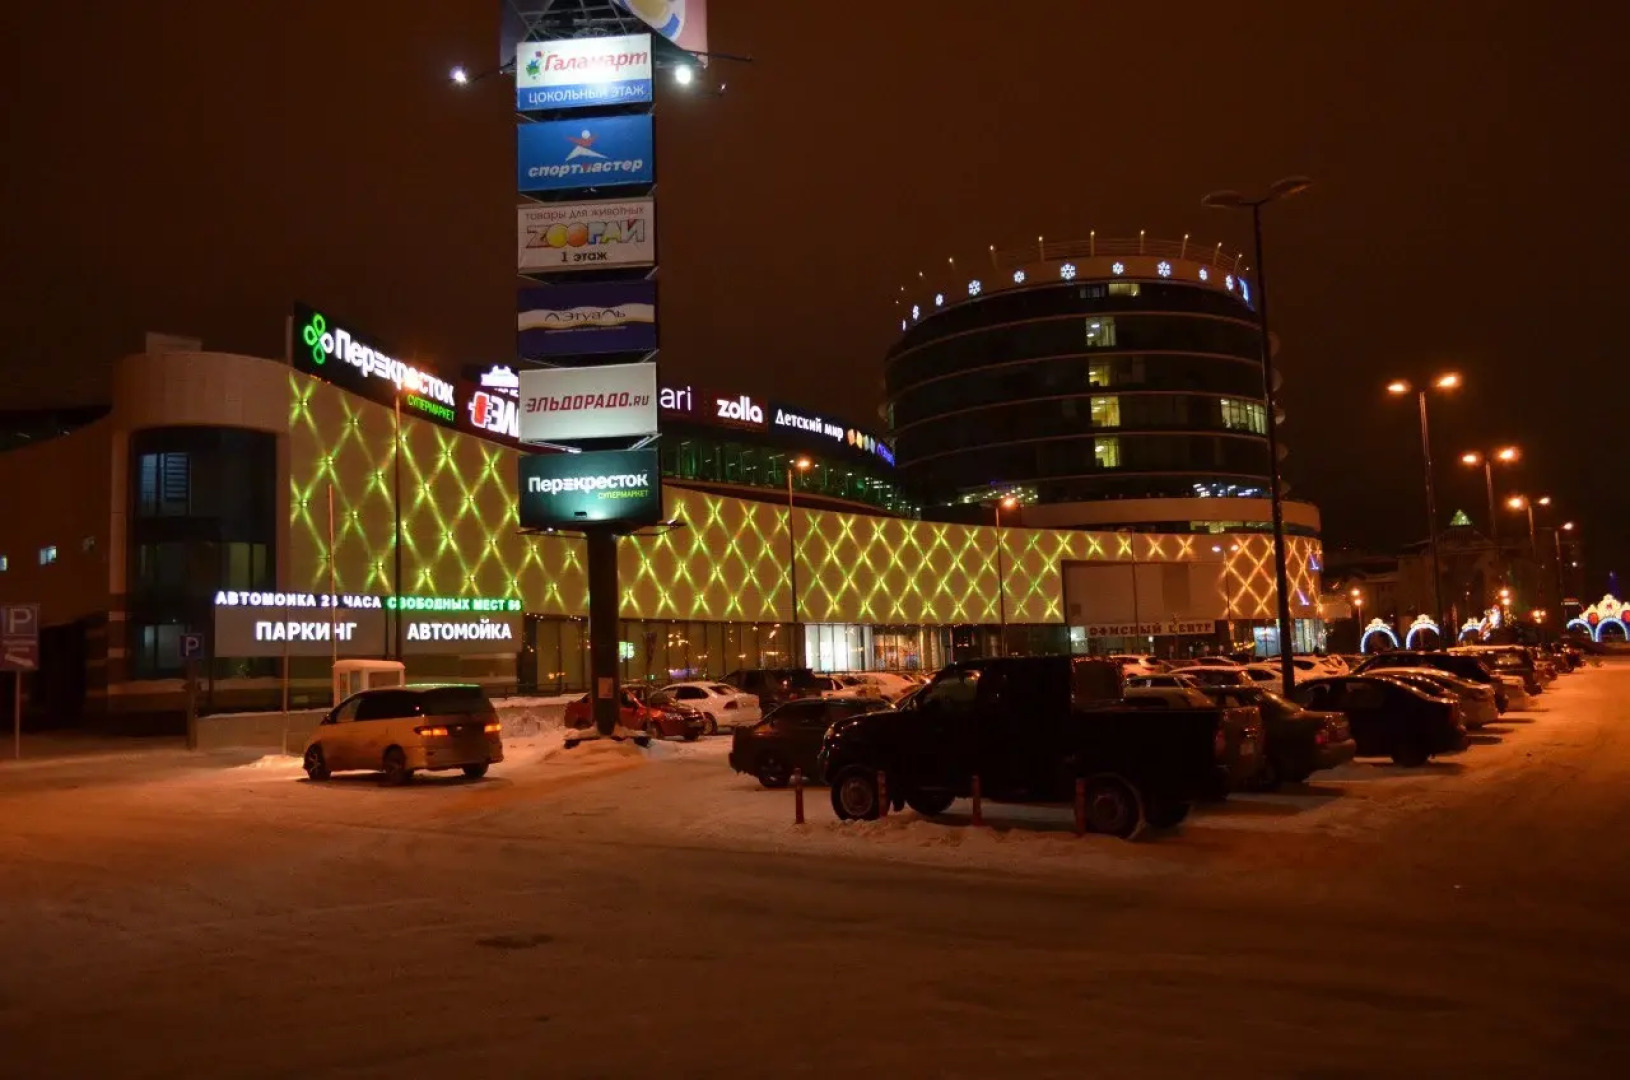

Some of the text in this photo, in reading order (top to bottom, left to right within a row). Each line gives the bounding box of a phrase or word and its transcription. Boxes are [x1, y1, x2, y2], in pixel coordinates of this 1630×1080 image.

[544, 51, 648, 71] Галамарт
[611, 85, 644, 98] ЭТАЖ
[528, 158, 643, 178] спортмастер
[525, 207, 644, 221] товары для животных
[561, 251, 607, 262] 1 этаж
[335, 327, 455, 406] Перекресток
[407, 394, 456, 422] СУПЕРМАРКЕТ
[659, 386, 692, 411] ari
[717, 396, 763, 424] zolla
[775, 409, 844, 442] Детский мир
[528, 472, 649, 495] Перекресток
[597, 489, 649, 500] СУПЕРМАРКЕТ
[344, 596, 382, 608] ЧАСА
[473, 599, 505, 611] МЕСТ
[255, 621, 357, 641] ПАРКИНГ
[407, 618, 512, 640] АВТОМОЙКА
